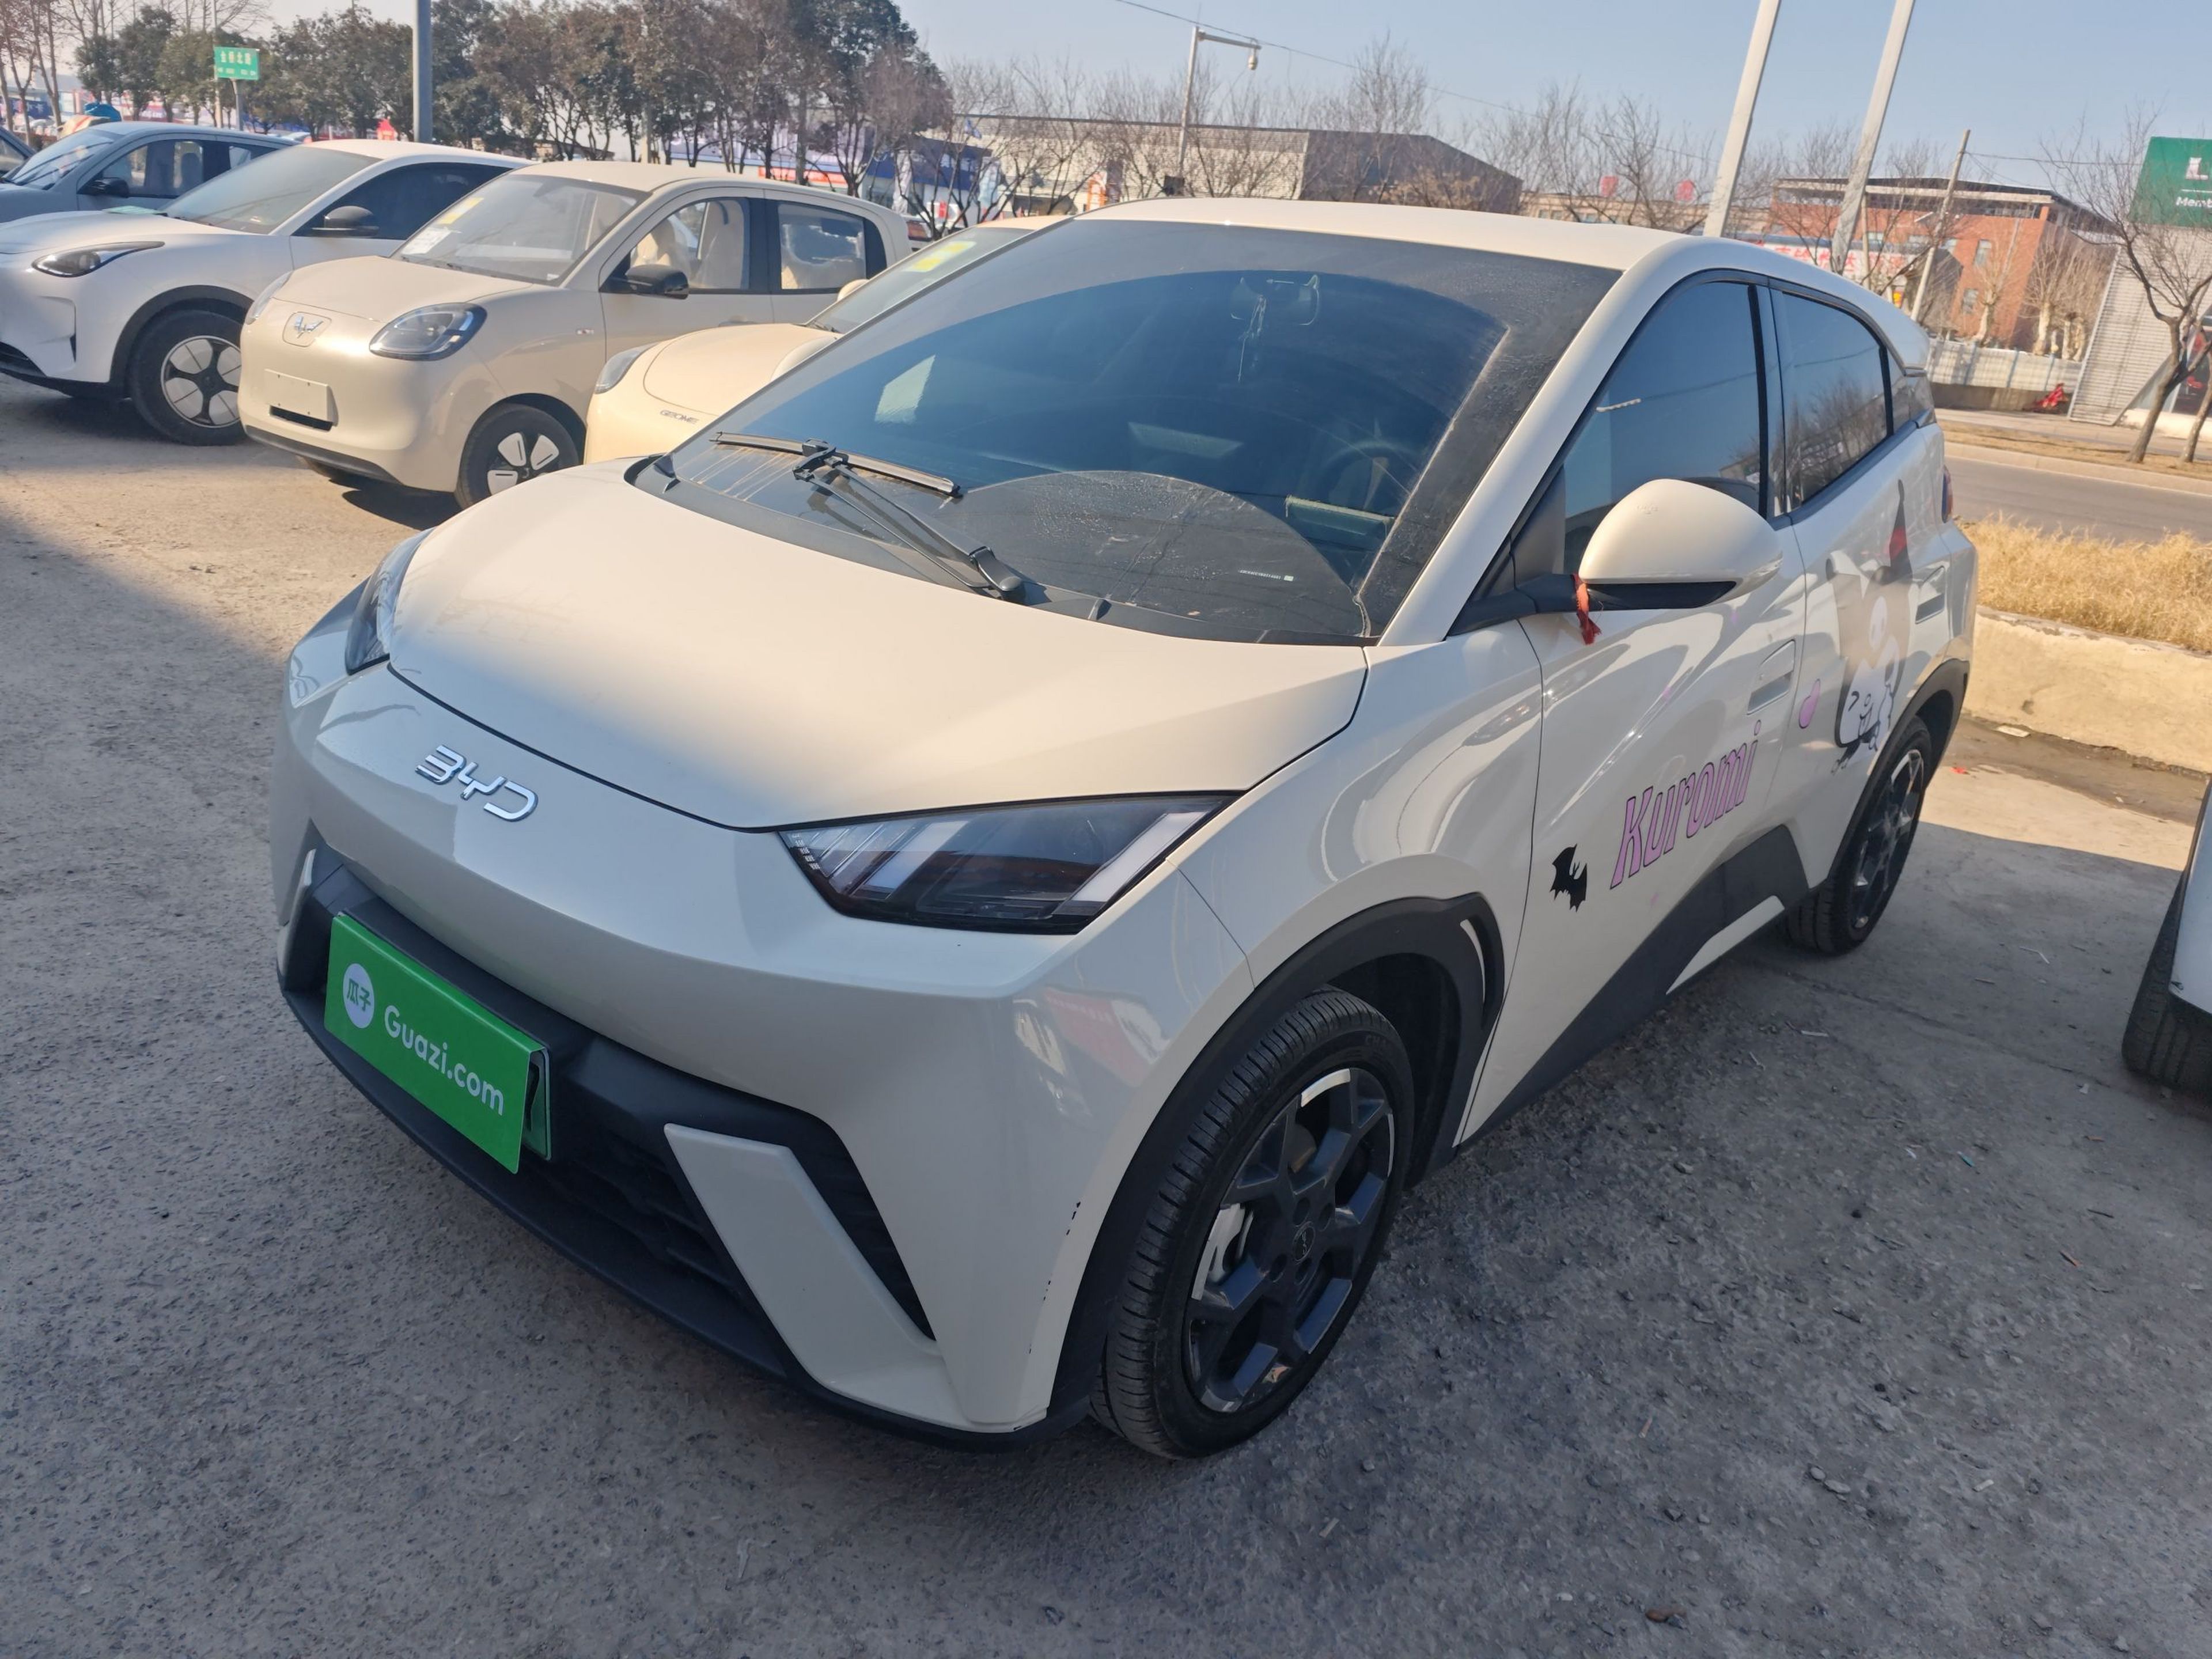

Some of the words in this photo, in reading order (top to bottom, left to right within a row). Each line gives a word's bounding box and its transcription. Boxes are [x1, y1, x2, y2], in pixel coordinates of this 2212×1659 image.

[660, 410, 699, 424] GEOME
[415, 745, 539, 822] BYD
[1610, 719, 1761, 889] Kuromi
[347, 978, 371, 1012] 瓜子
[384, 1005, 504, 1116] Guazi.com
